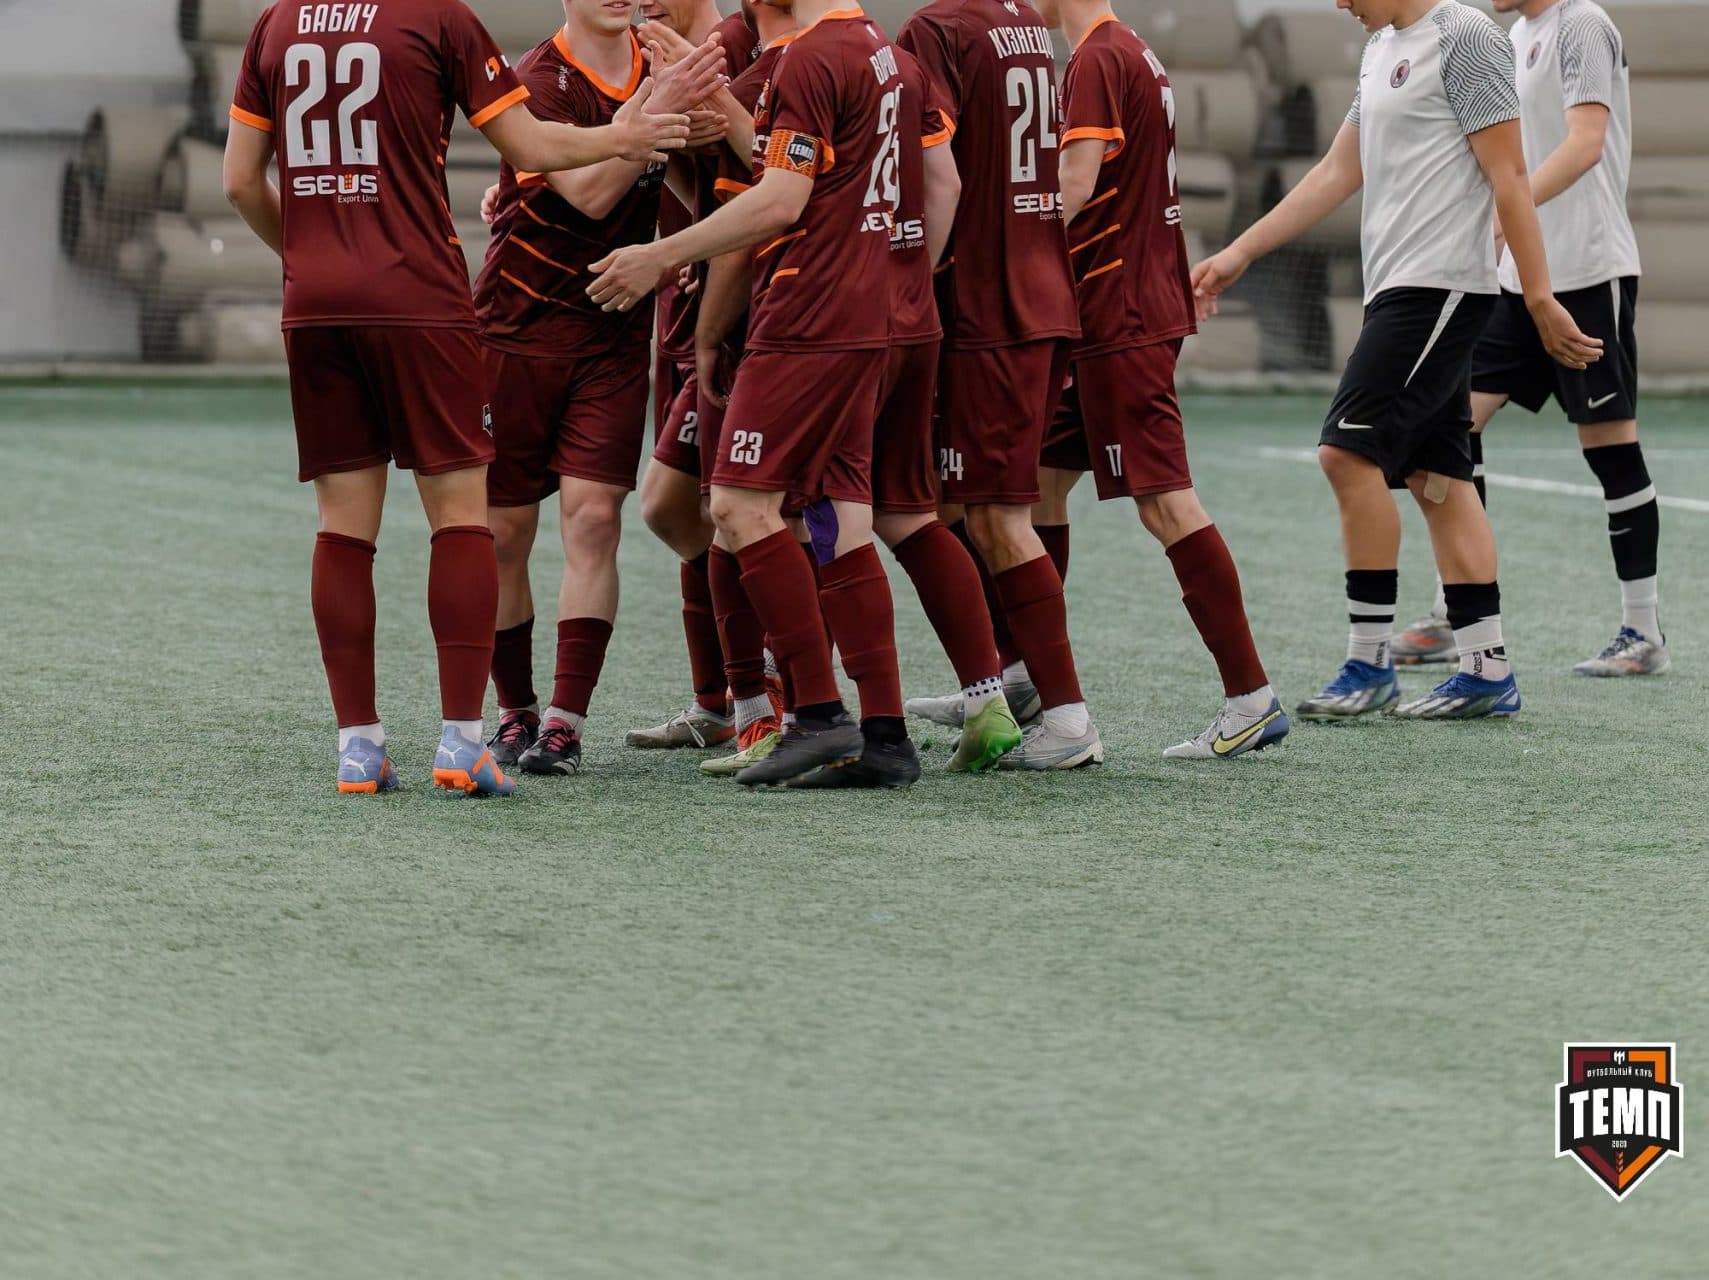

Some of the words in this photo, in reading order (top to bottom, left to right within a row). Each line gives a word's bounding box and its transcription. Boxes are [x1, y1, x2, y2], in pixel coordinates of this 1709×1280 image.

[298, 3, 379, 34] БАБИЧ
[284, 42, 381, 168] 22
[1006, 67, 1057, 183] 24
[293, 173, 378, 197] SEUS
[677, 411, 700, 446] 2
[730, 430, 764, 465] 23
[940, 448, 964, 481] 24
[1105, 444, 1122, 477] 17
